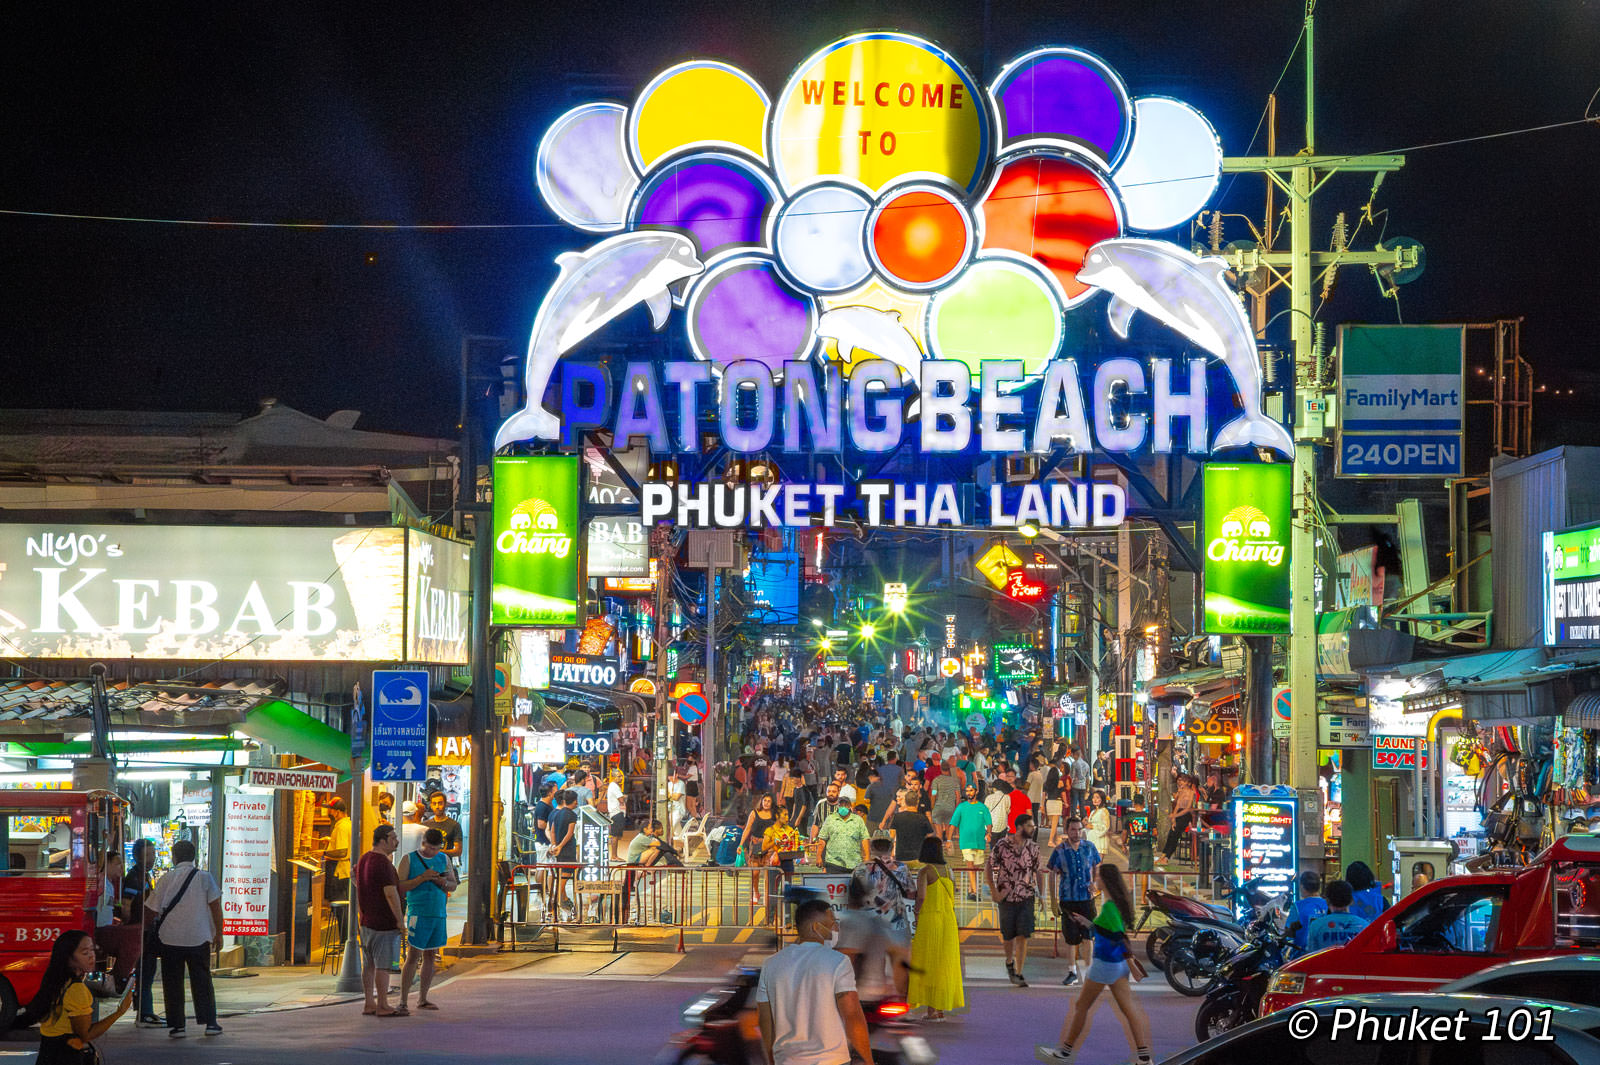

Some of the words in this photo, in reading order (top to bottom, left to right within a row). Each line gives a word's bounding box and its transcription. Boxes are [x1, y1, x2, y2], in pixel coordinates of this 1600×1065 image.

[801, 80, 964, 109] WELCOME
[858, 130, 897, 156] TO
[560, 359, 904, 452] PATONG
[920, 358, 1208, 453] BEACH
[1346, 389, 1458, 410] FamilyMart
[642, 483, 844, 526] PHUKET
[496, 530, 572, 559] Chang
[1207, 537, 1285, 567] Chang
[32, 567, 337, 636] KEBAB
[418, 575, 460, 641] KEBAB
[551, 662, 617, 686] TATTOO
[252, 771, 273, 785] TOUR
[275, 773, 335, 789] INFORMATION
[232, 801, 266, 811] Private
[1244, 871, 1251, 879] H
[229, 886, 263, 895] TICKET
[224, 901, 243, 914] City
[245, 901, 266, 912] Tour
[15, 927, 28, 942] B
